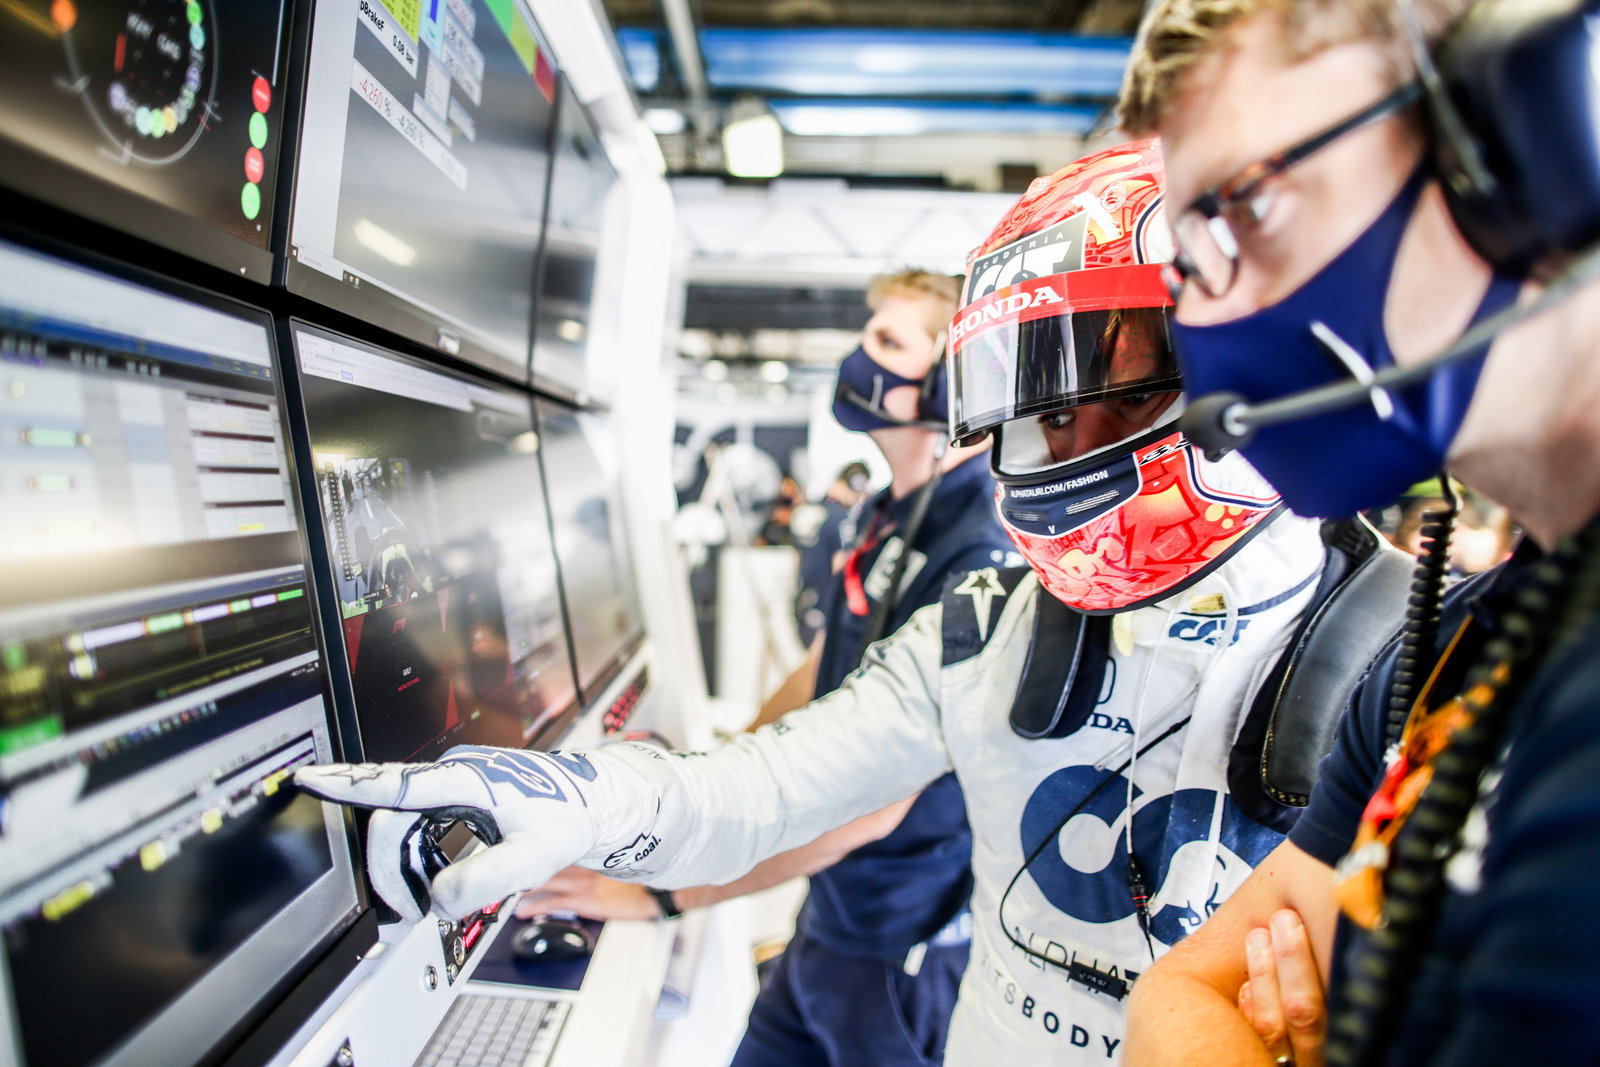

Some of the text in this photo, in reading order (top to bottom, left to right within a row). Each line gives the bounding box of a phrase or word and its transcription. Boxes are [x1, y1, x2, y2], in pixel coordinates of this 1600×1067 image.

[975, 232, 1064, 275] SCUDERIA
[952, 286, 1064, 342] HONDA
[1010, 470, 1109, 499] ALPHATAURI.COM/FASHION
[634, 836, 662, 862] Goal.
